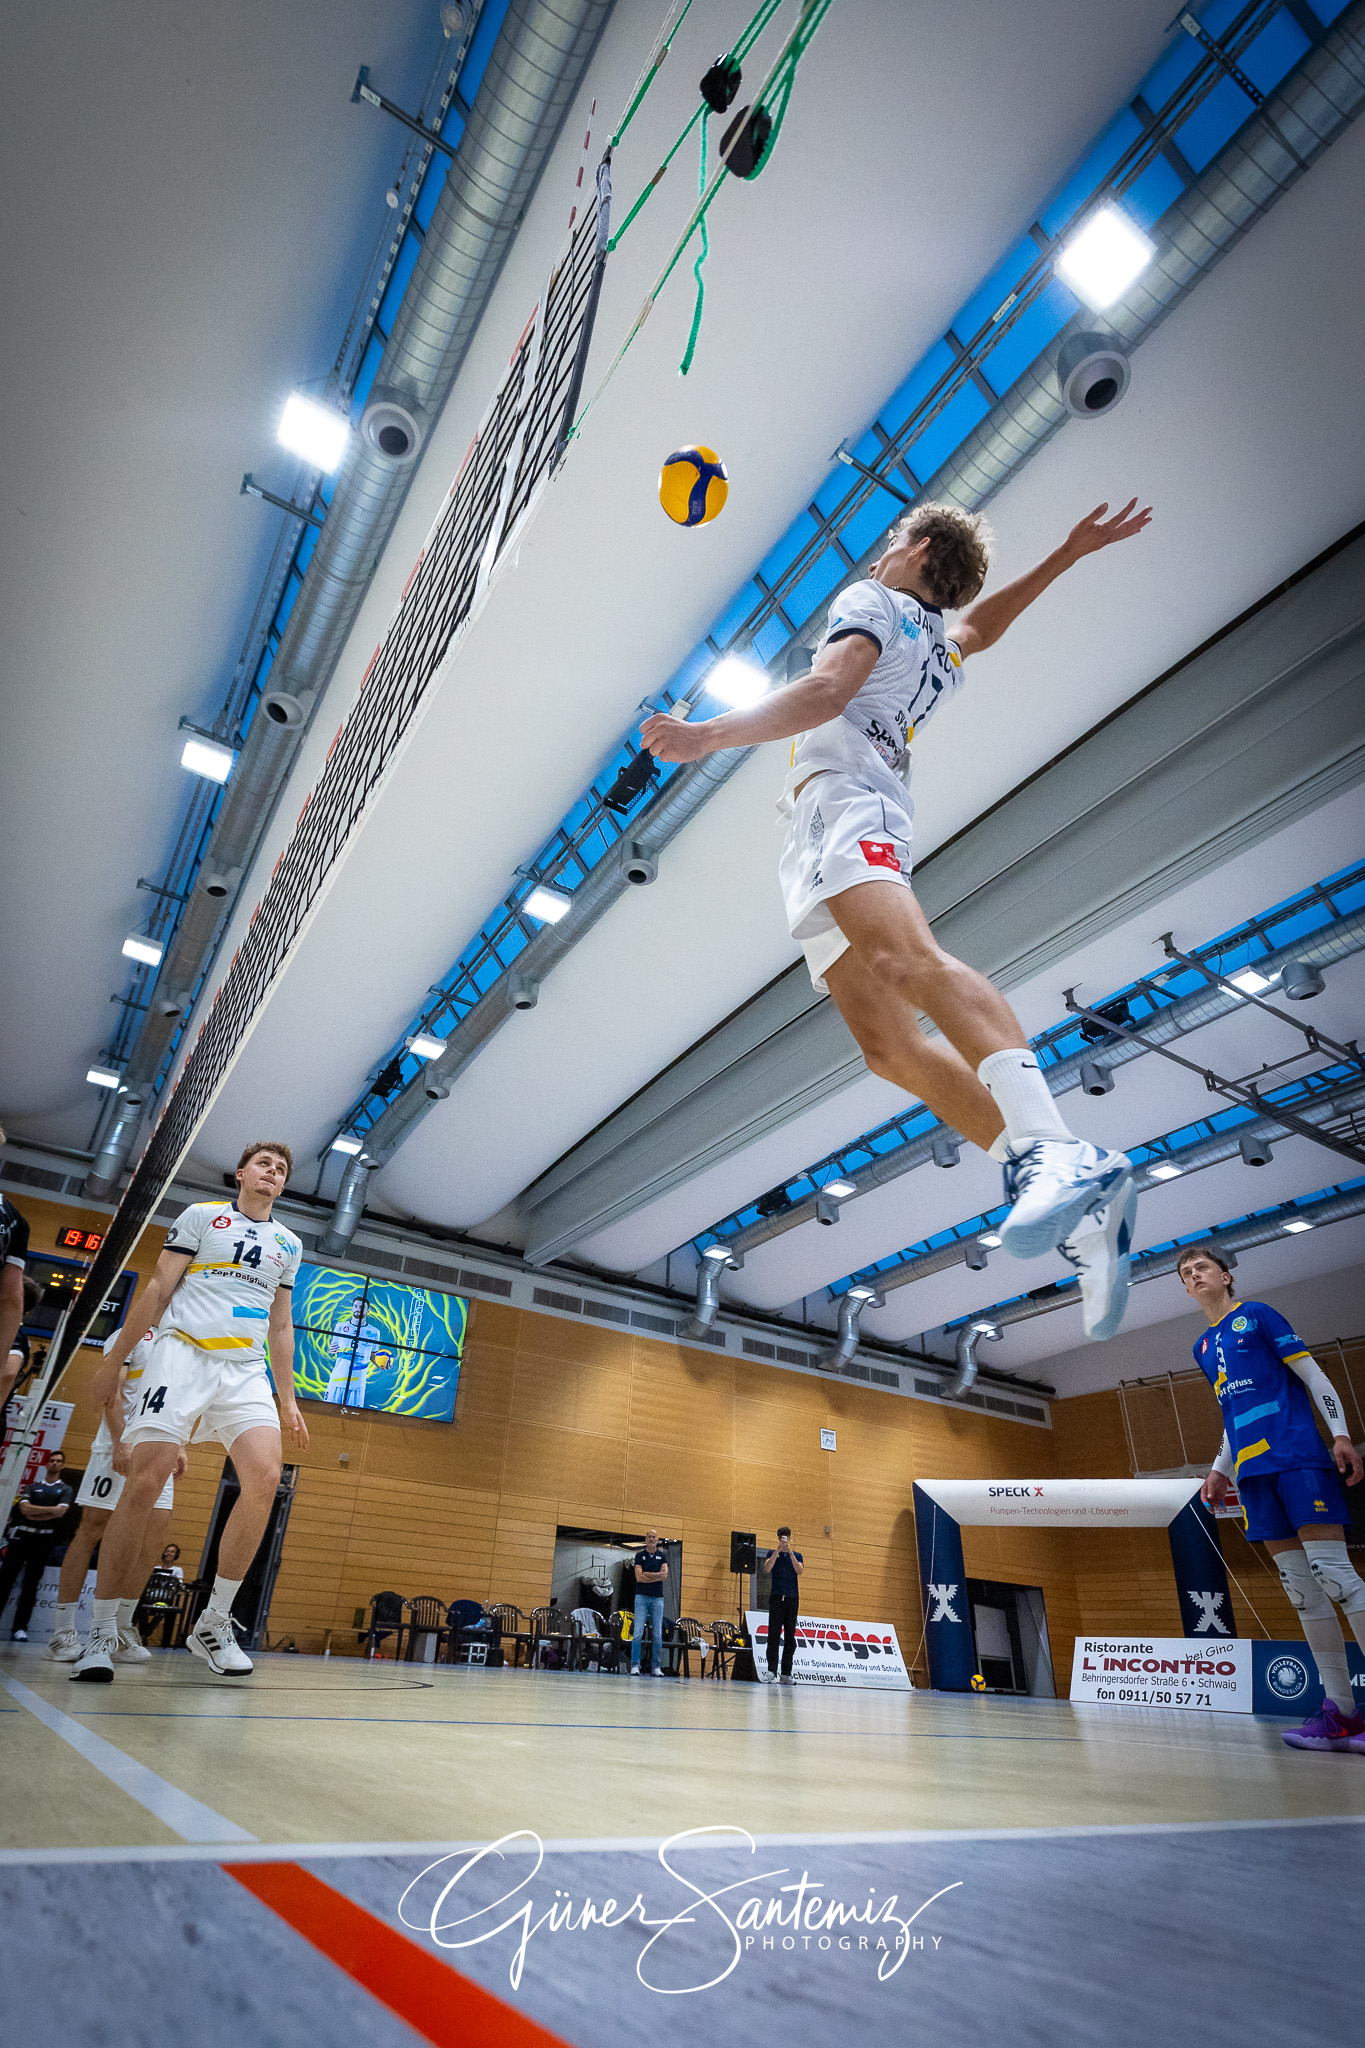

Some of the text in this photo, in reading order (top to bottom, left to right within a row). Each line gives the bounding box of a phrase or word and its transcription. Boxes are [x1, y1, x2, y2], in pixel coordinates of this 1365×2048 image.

[64, 1229, 102, 1251] 19:16
[232, 1241, 262, 1269] 14
[140, 1386, 168, 1416] 14
[90, 1475, 113, 1498] 10
[988, 1486, 1031, 1497] SPECK
[990, 1507, 1129, 1516] Pumpen-Technologien und -Lösungen
[1084, 1642, 1154, 1654] Ristorante
[1185, 1643, 1234, 1662] bei Gino
[801, 1658, 810, 1667] für
[849, 1663, 867, 1672] Hobby
[869, 1664, 881, 1672] und
[881, 1664, 902, 1673] Schule
[1271, 1660, 1302, 1675] VOLLEYBALL
[1081, 1673, 1237, 1692] Behringersdorfer Straße 6 Schwaig
[1272, 1681, 1303, 1695] BUNDESLIGA
[1097, 1688, 1212, 1706] fon 0911/50 57 71
